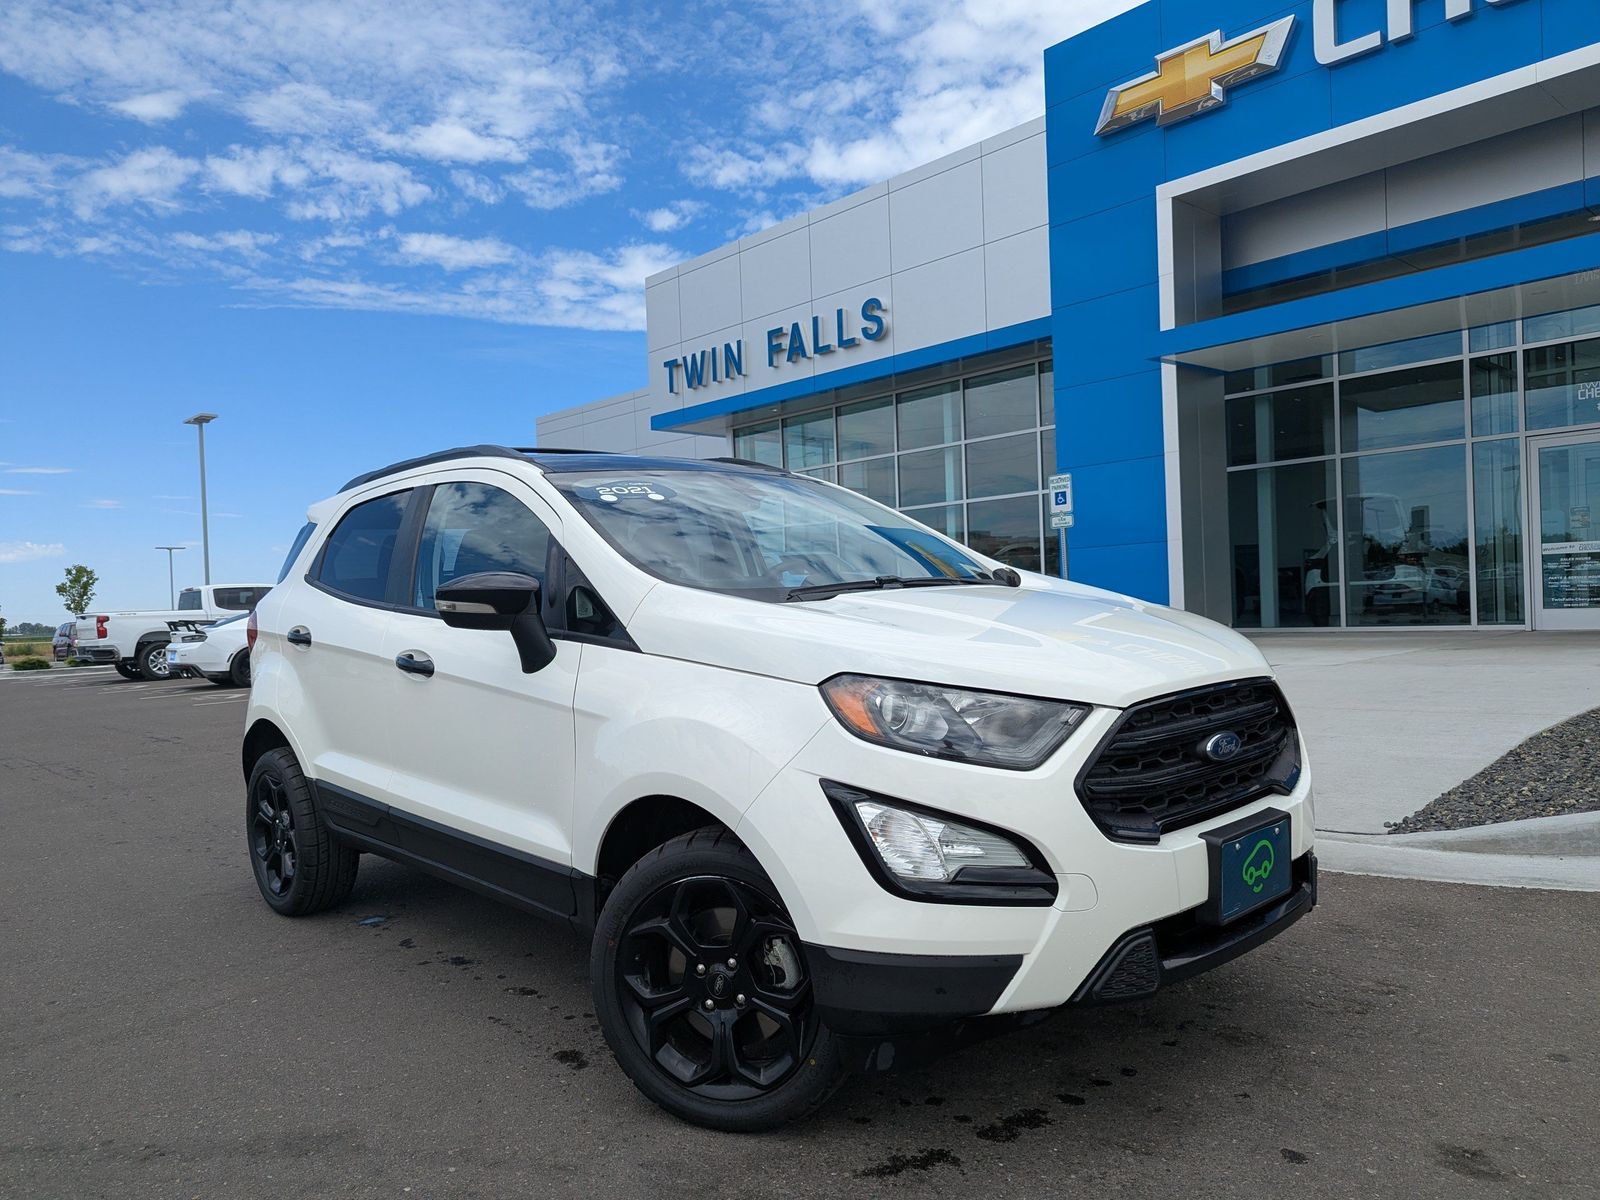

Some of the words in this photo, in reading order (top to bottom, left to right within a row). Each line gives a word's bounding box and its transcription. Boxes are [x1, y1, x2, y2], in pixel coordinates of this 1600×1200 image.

[663, 339, 747, 394] TWIN
[767, 297, 888, 368] FALLS
[596, 486, 656, 495] 2021
